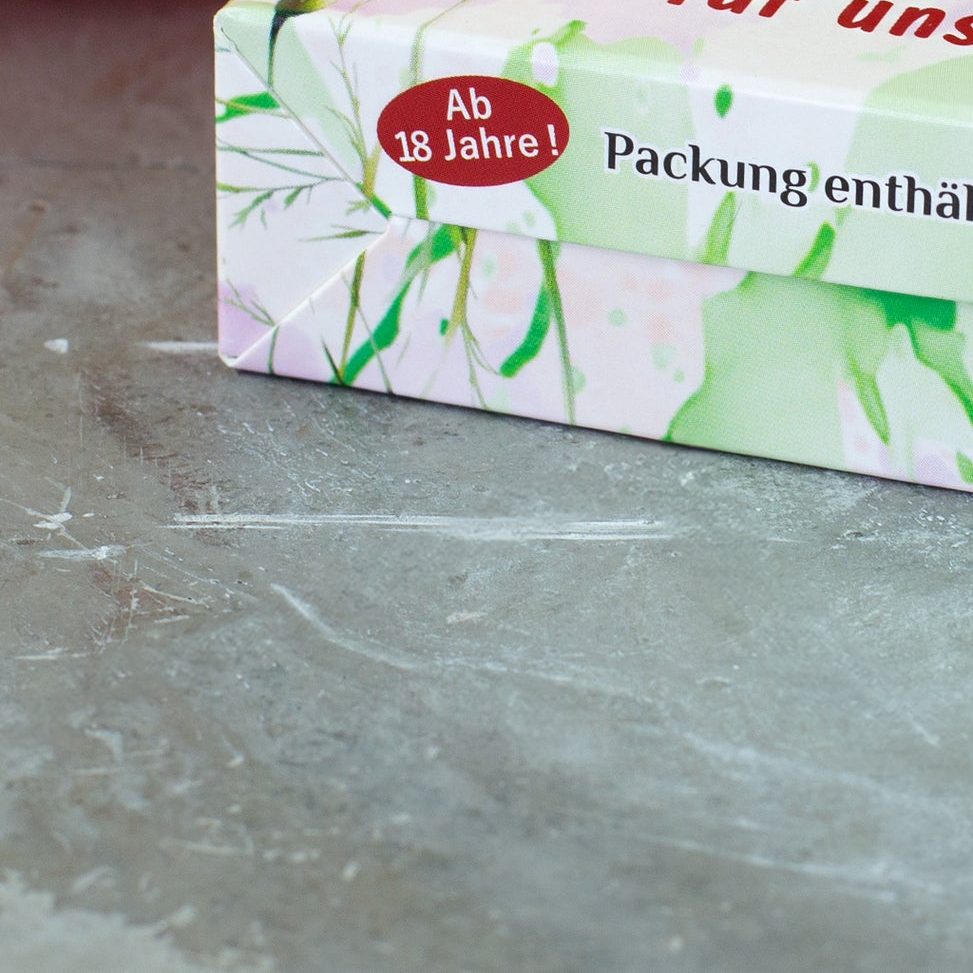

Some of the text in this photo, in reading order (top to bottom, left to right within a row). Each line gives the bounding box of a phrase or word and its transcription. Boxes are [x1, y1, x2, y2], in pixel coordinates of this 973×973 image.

[446, 88, 492, 121] Ab
[395, 131, 432, 162] 18
[604, 131, 808, 208] Packung
